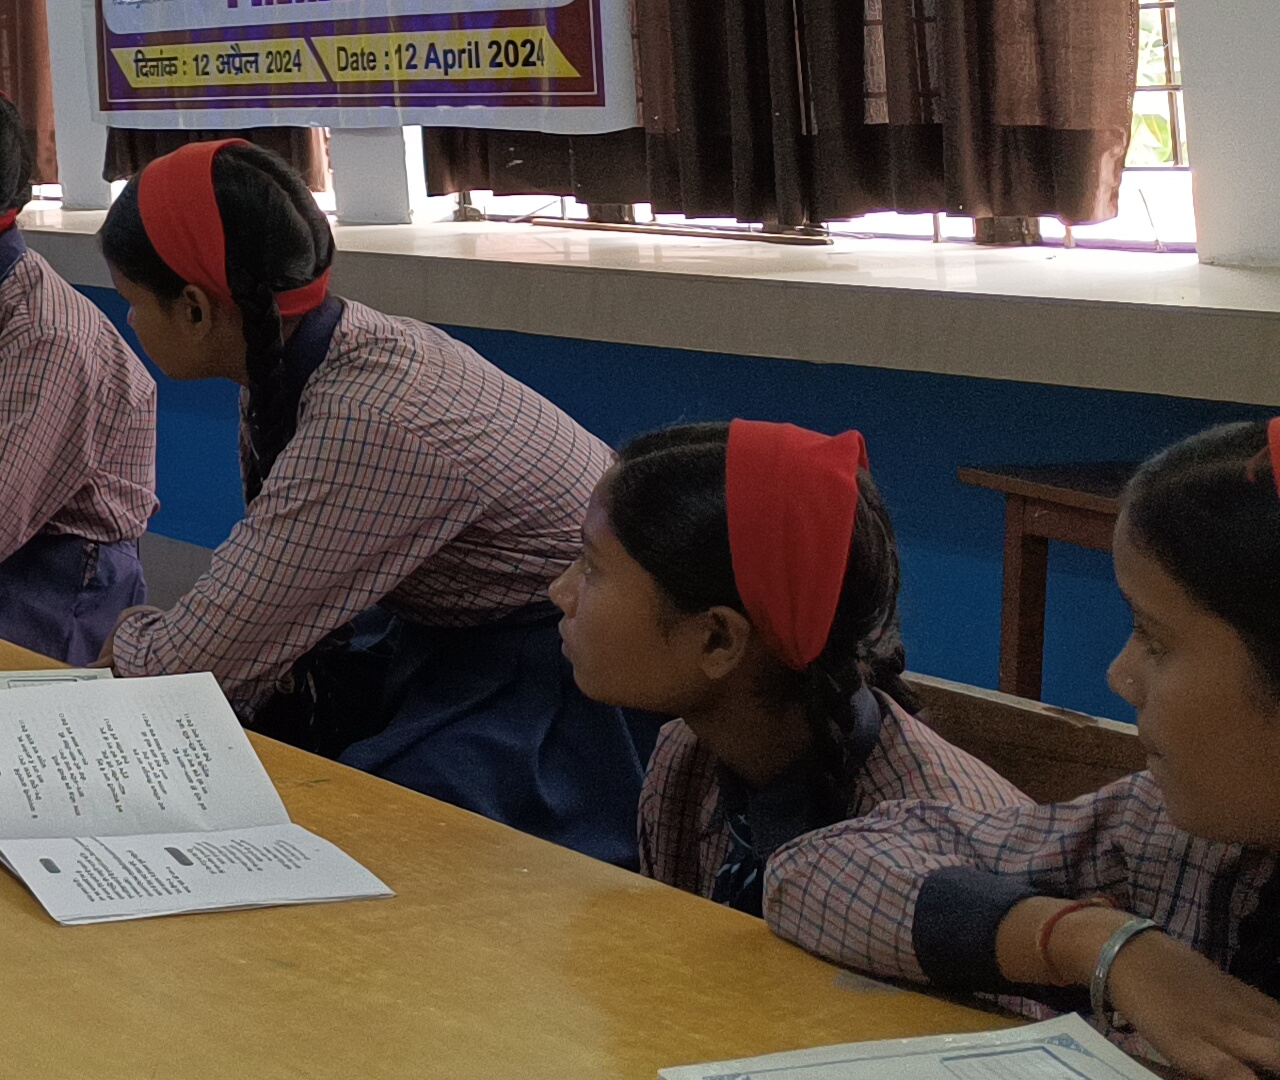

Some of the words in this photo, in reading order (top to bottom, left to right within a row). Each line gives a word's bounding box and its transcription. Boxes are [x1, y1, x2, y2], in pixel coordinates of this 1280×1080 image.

[133, 49, 178, 78] दिनांक
[192, 54, 210, 76] 12
[216, 43, 259, 76] अप्रैल
[265, 49, 302, 74] 2024
[336, 45, 377, 72] Date
[394, 42, 418, 70] 12
[424, 41, 481, 76] April
